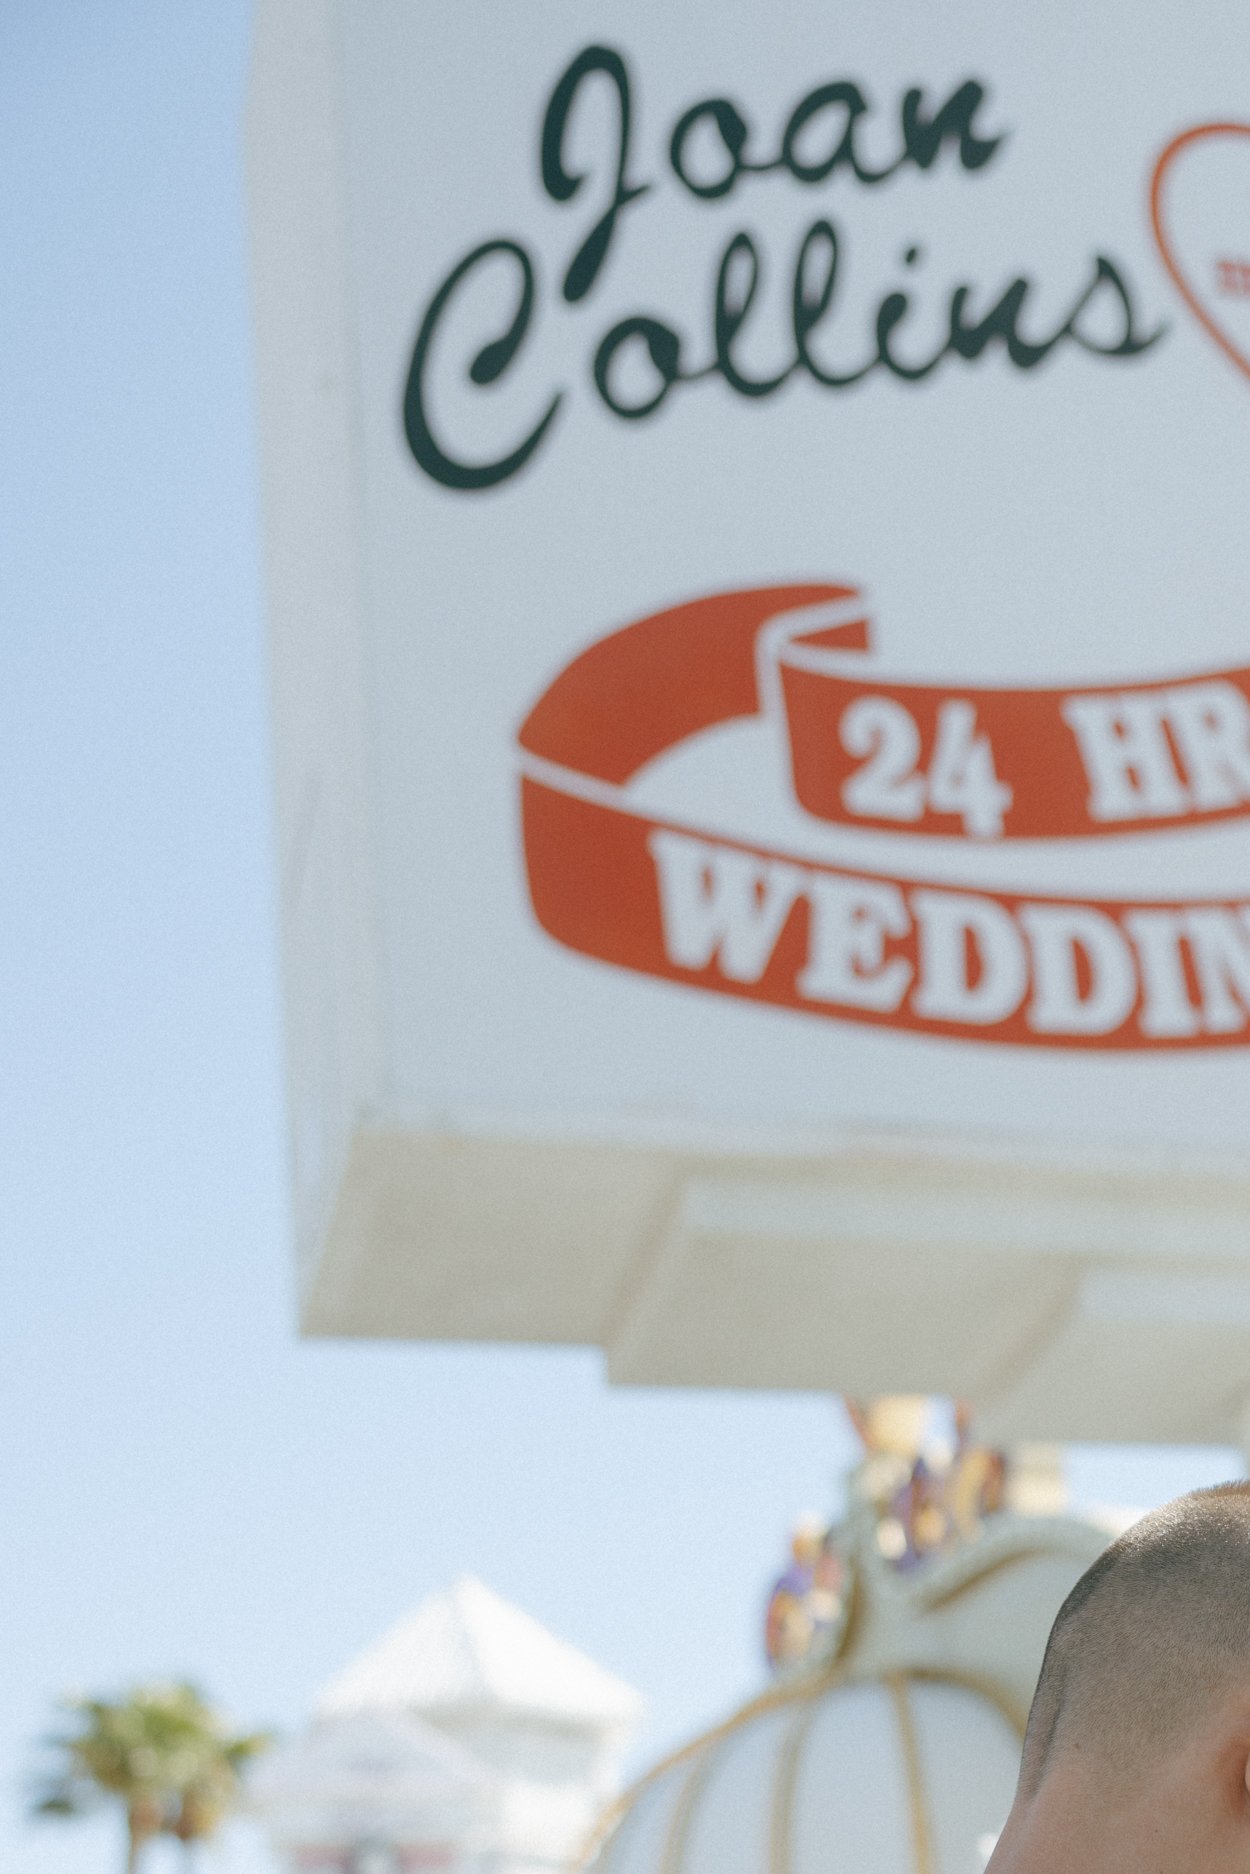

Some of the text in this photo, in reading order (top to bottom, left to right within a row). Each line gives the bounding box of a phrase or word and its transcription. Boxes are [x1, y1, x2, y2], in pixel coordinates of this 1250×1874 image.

[541, 44, 1009, 304] Joan
[402, 219, 1168, 491] Collins
[840, 696, 1012, 838] 24
